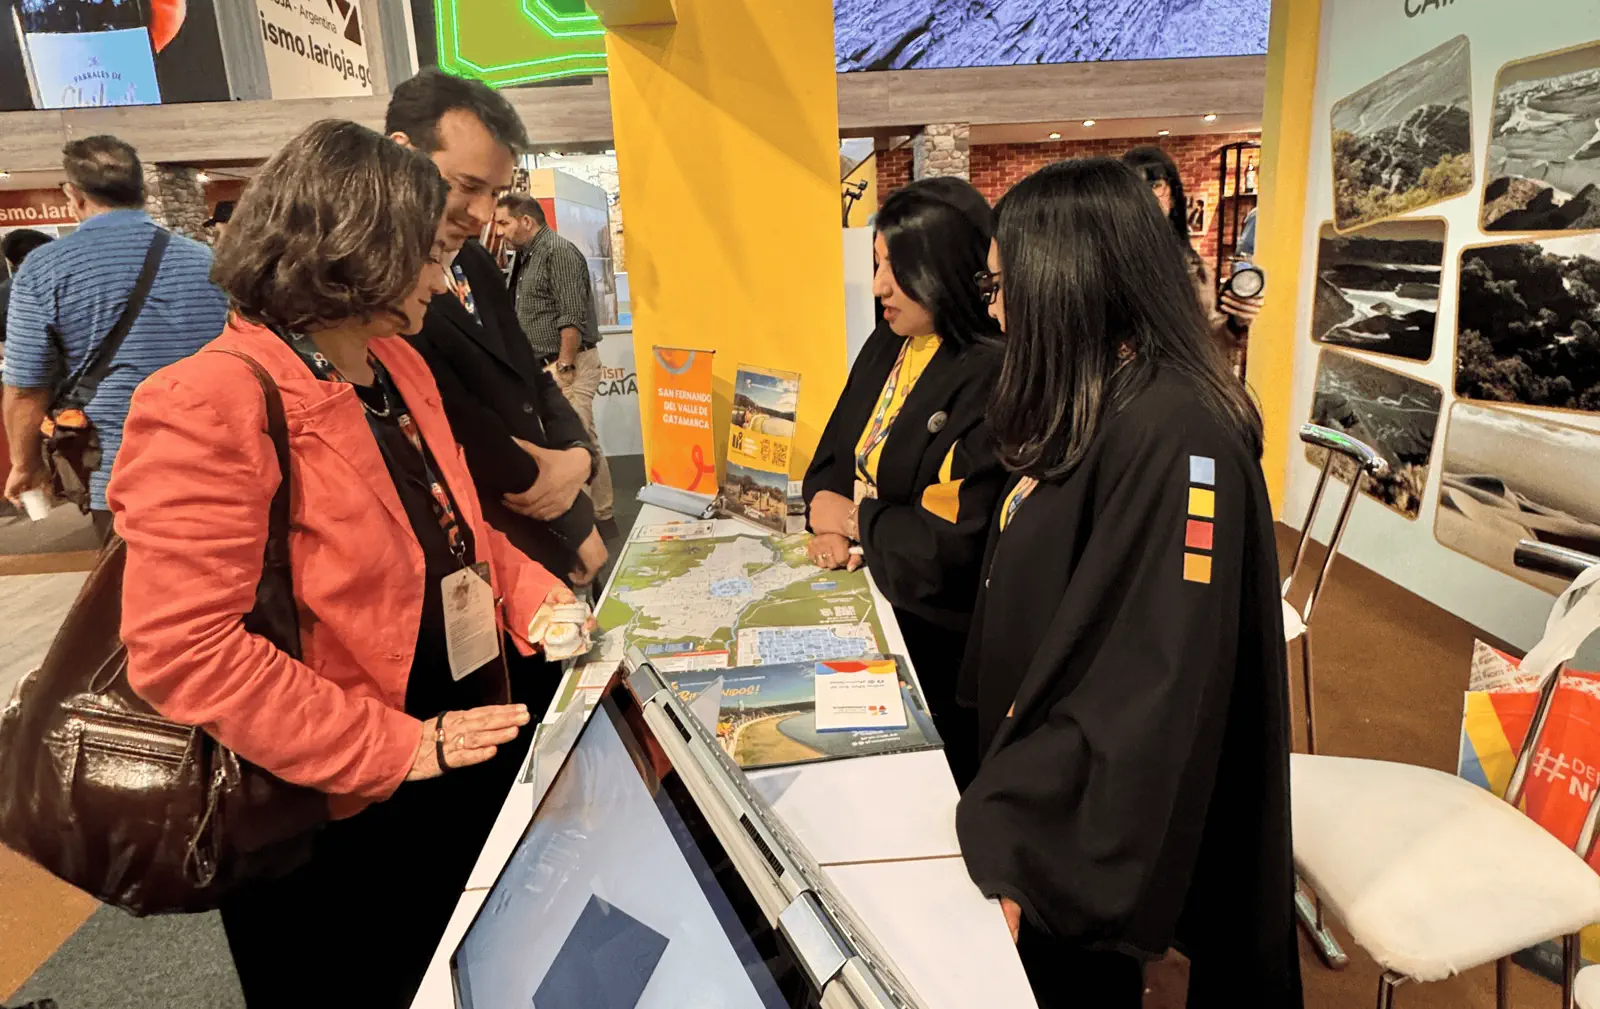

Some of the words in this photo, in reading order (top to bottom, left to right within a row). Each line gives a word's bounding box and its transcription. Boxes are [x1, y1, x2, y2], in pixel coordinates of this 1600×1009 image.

[299, 6, 338, 34] Argentina
[73, 70, 110, 83] PARRALES
[111, 71, 122, 81] DE
[657, 387, 675, 398] SAN
[675, 389, 712, 403] FERNANDO
[663, 400, 677, 412] DEL
[678, 403, 698, 415] VALLE
[698, 406, 709, 417] DE
[662, 413, 710, 430] CATAMARCA
